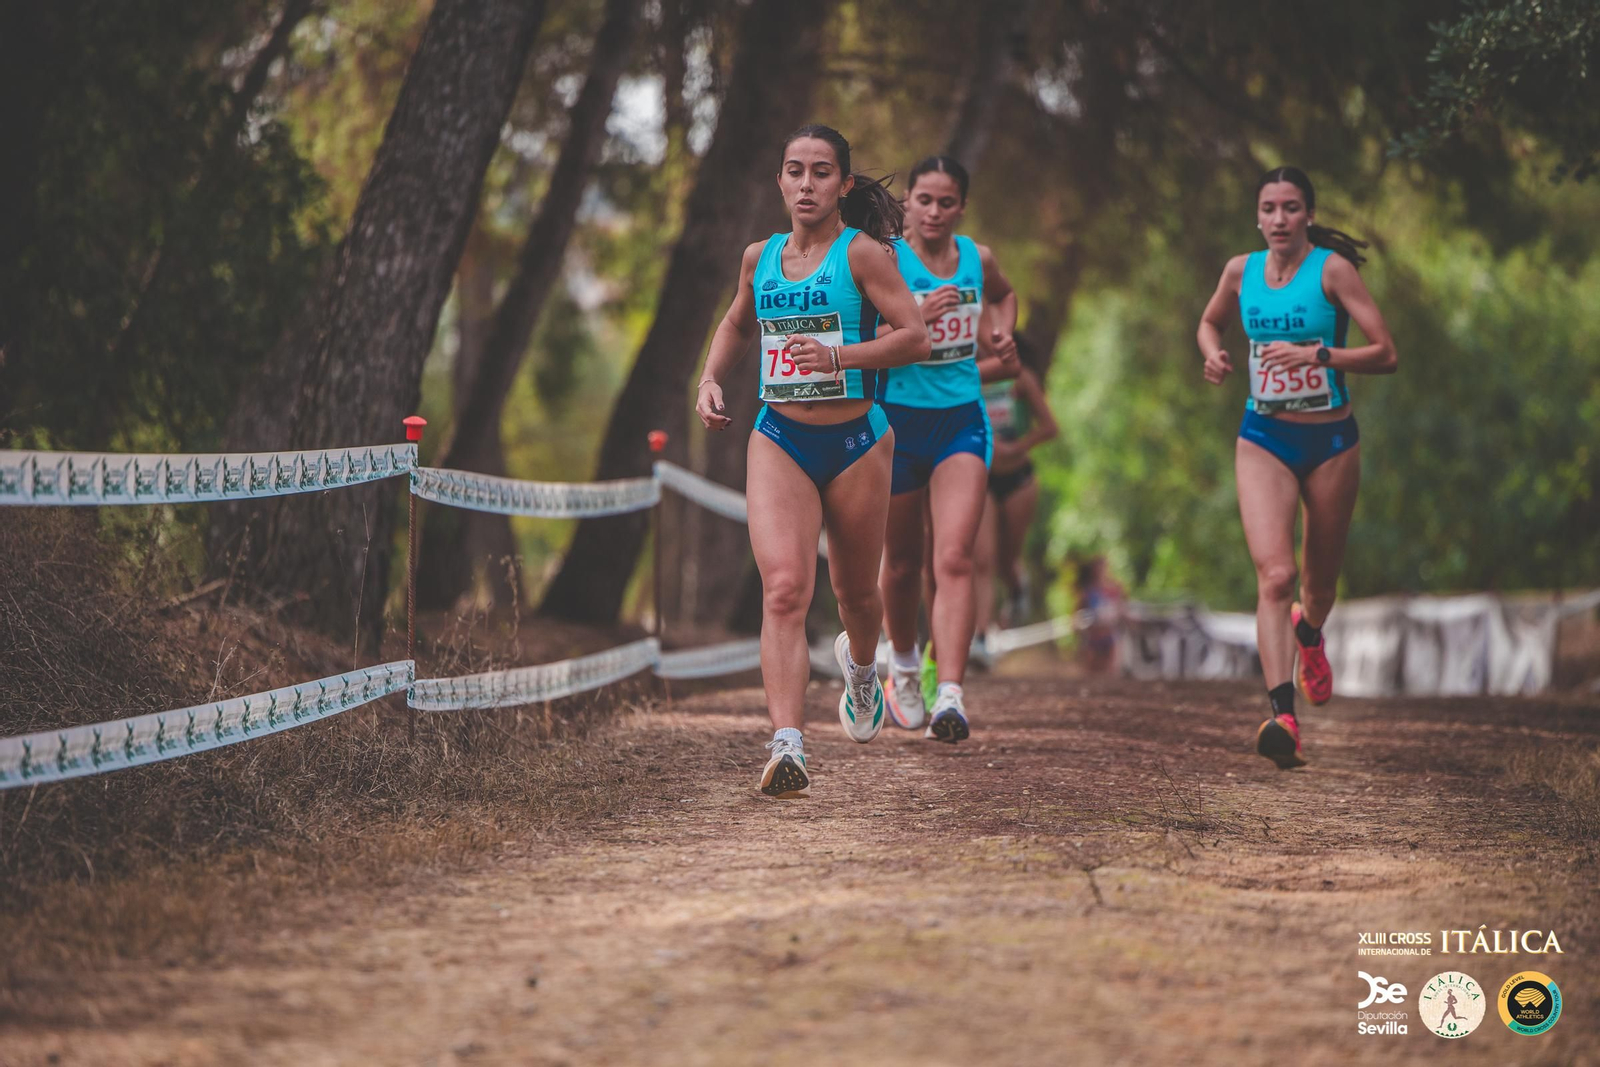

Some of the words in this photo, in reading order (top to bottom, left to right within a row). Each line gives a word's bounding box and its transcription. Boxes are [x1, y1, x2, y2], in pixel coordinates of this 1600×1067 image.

[760, 285, 829, 312] nerja
[931, 315, 973, 343] 591
[1249, 313, 1305, 332] nerja
[767, 349, 833, 377] 75
[1257, 365, 1322, 394] 7556
